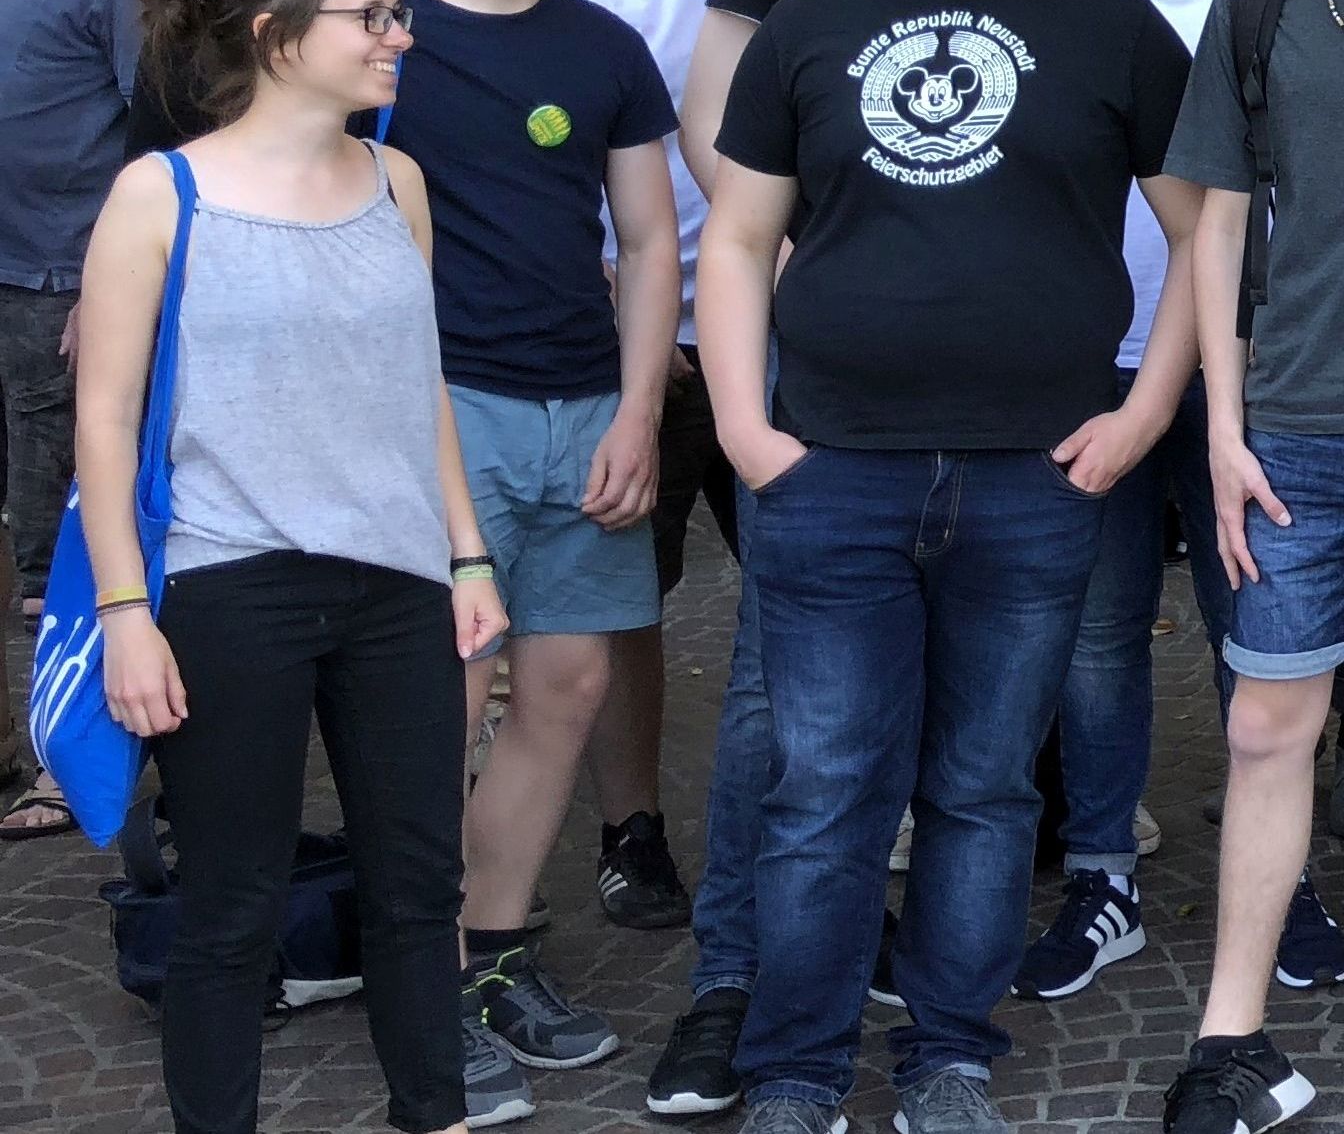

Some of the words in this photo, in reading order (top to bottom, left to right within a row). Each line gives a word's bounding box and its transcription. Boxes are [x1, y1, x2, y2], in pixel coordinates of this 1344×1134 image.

[847, 33, 892, 78] Bunte
[891, 10, 974, 39] Republik
[976, 14, 1037, 72] Neustadt
[861, 144, 1005, 186] Feierschutzgebiet
